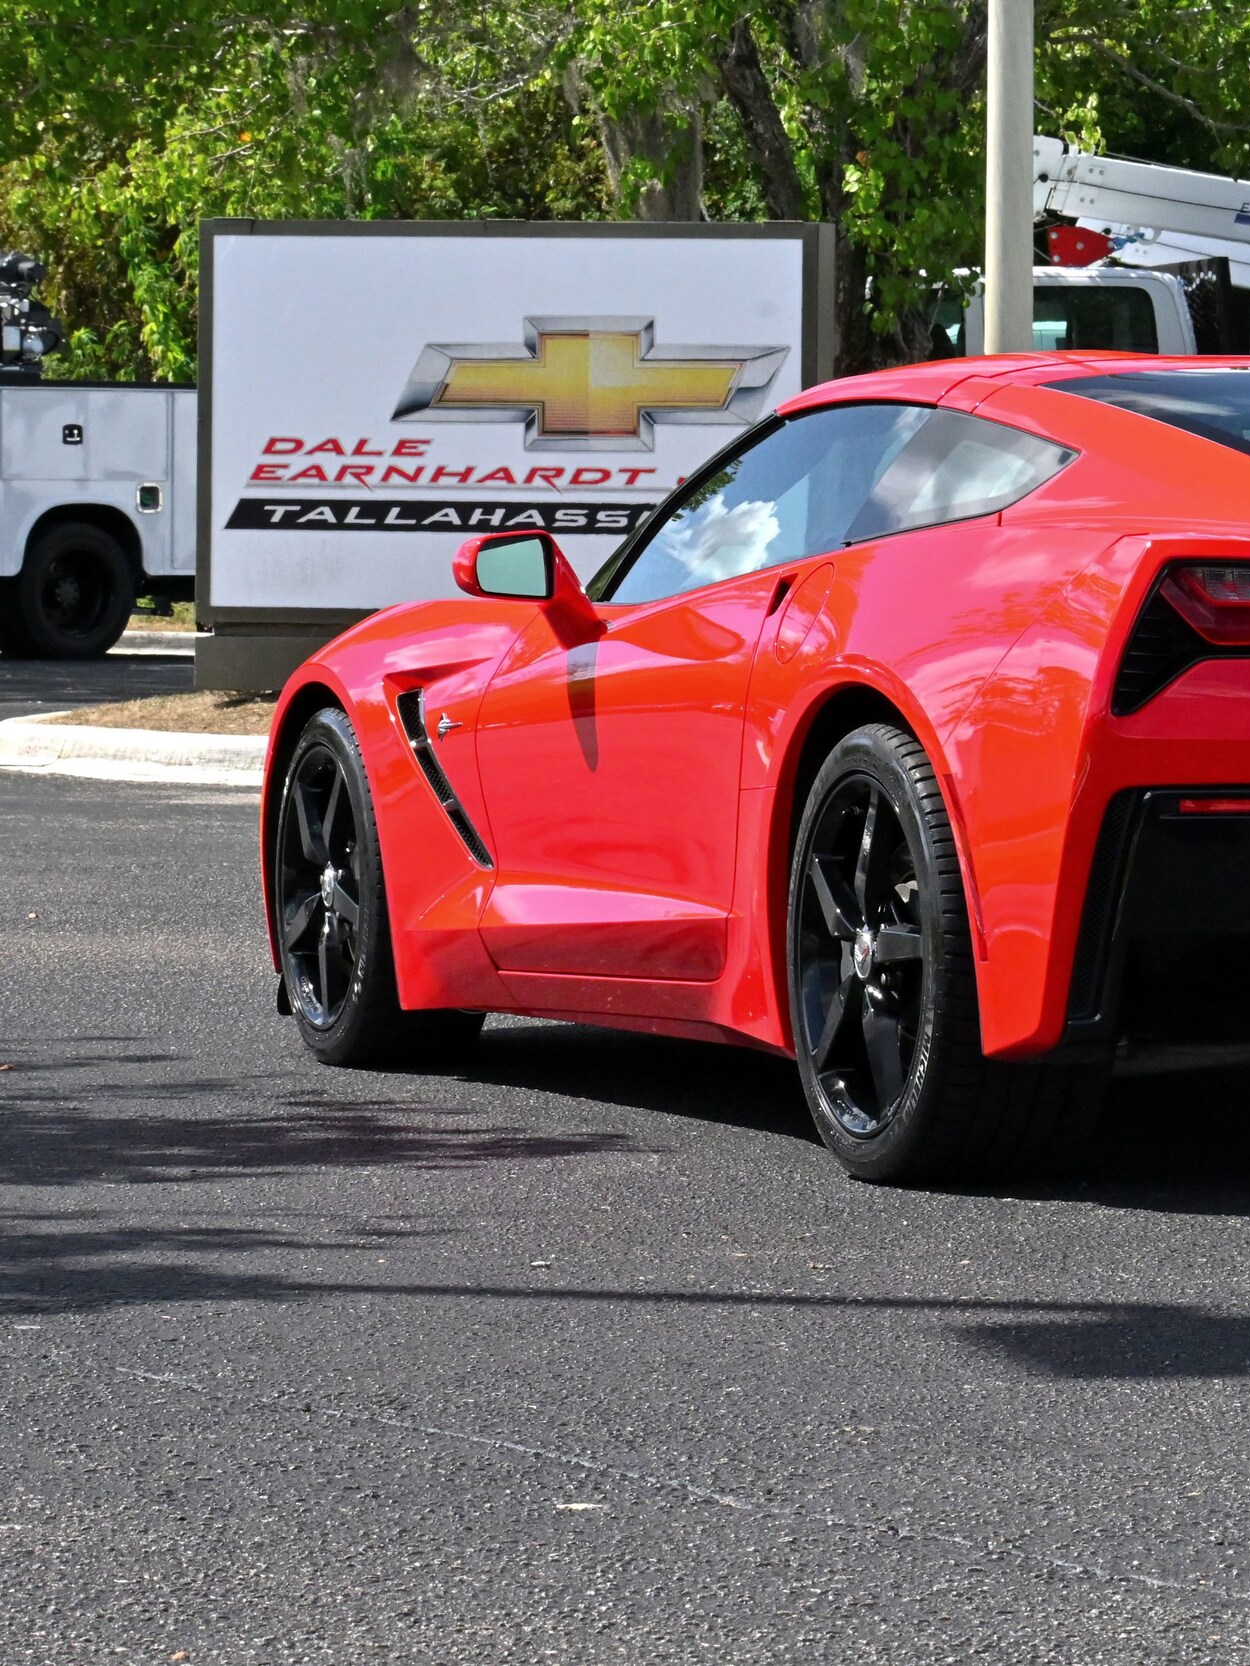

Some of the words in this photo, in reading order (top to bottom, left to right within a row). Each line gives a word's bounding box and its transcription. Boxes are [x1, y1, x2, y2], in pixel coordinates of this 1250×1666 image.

[261, 436, 433, 457] DALE
[249, 464, 657, 494] EARNHARDT
[263, 505, 652, 528] TALLAHASS
